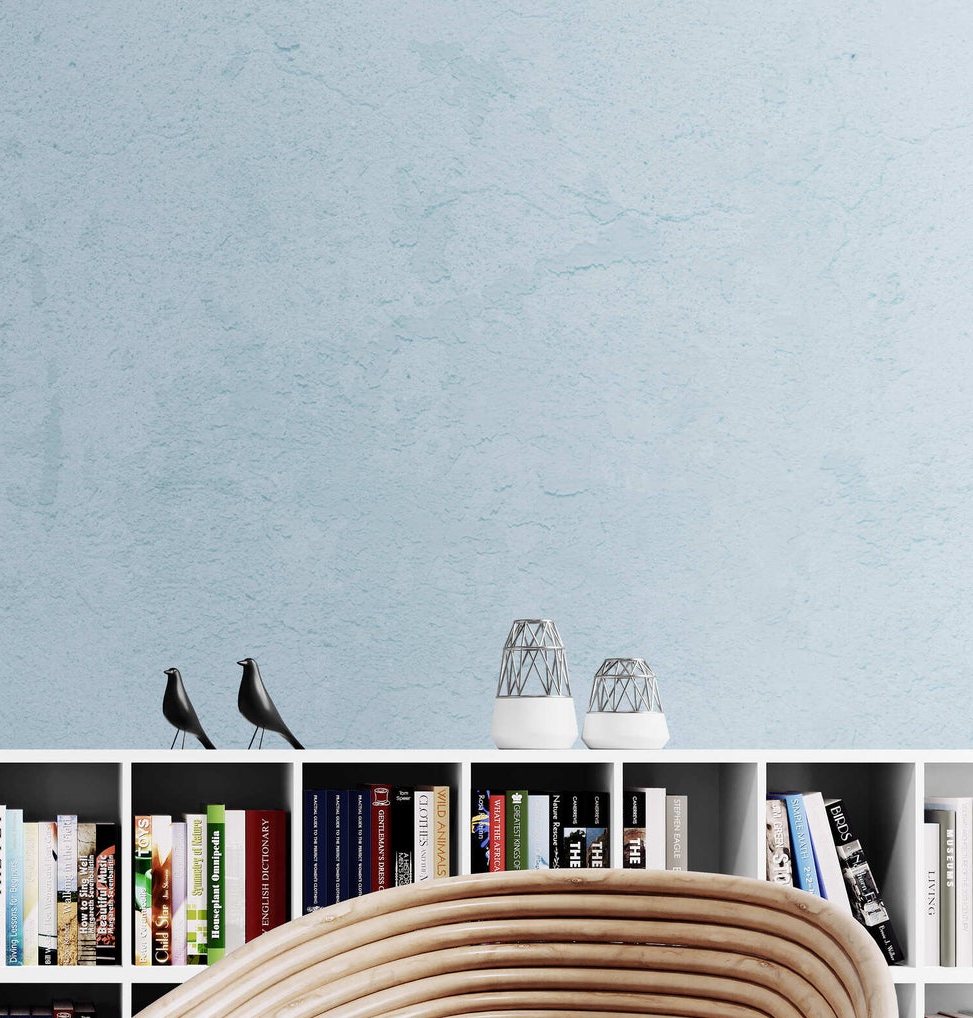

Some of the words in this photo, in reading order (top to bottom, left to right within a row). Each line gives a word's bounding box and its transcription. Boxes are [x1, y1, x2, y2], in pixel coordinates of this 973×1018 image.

[437, 789, 446, 818] WILD
[791, 799, 804, 830] SIMPLE
[419, 795, 428, 846] CLOTHES
[831, 805, 852, 842] BIRDS
[138, 818, 149, 857] TOYS
[437, 821, 446, 876] ANIMALS
[630, 838, 641, 864] THE
[80, 855, 88, 875] Well
[212, 831, 222, 881] Omnipedia
[514, 860, 521, 870] OF
[570, 842, 581, 868] THE
[592, 841, 603, 868] THE
[946, 829, 954, 888] MUSEUMS
[97, 855, 107, 887] Music
[10, 895, 18, 906] for
[62, 874, 73, 914] Walking
[80, 878, 89, 898] Sing
[81, 901, 88, 910] to
[97, 886, 107, 934] Beautiful
[156, 905, 169, 928] Star
[212, 885, 222, 938] Houseplant
[10, 908, 18, 937] Lessons
[80, 913, 88, 934] How
[10, 939, 19, 963] Diving
[155, 931, 169, 963] Child
